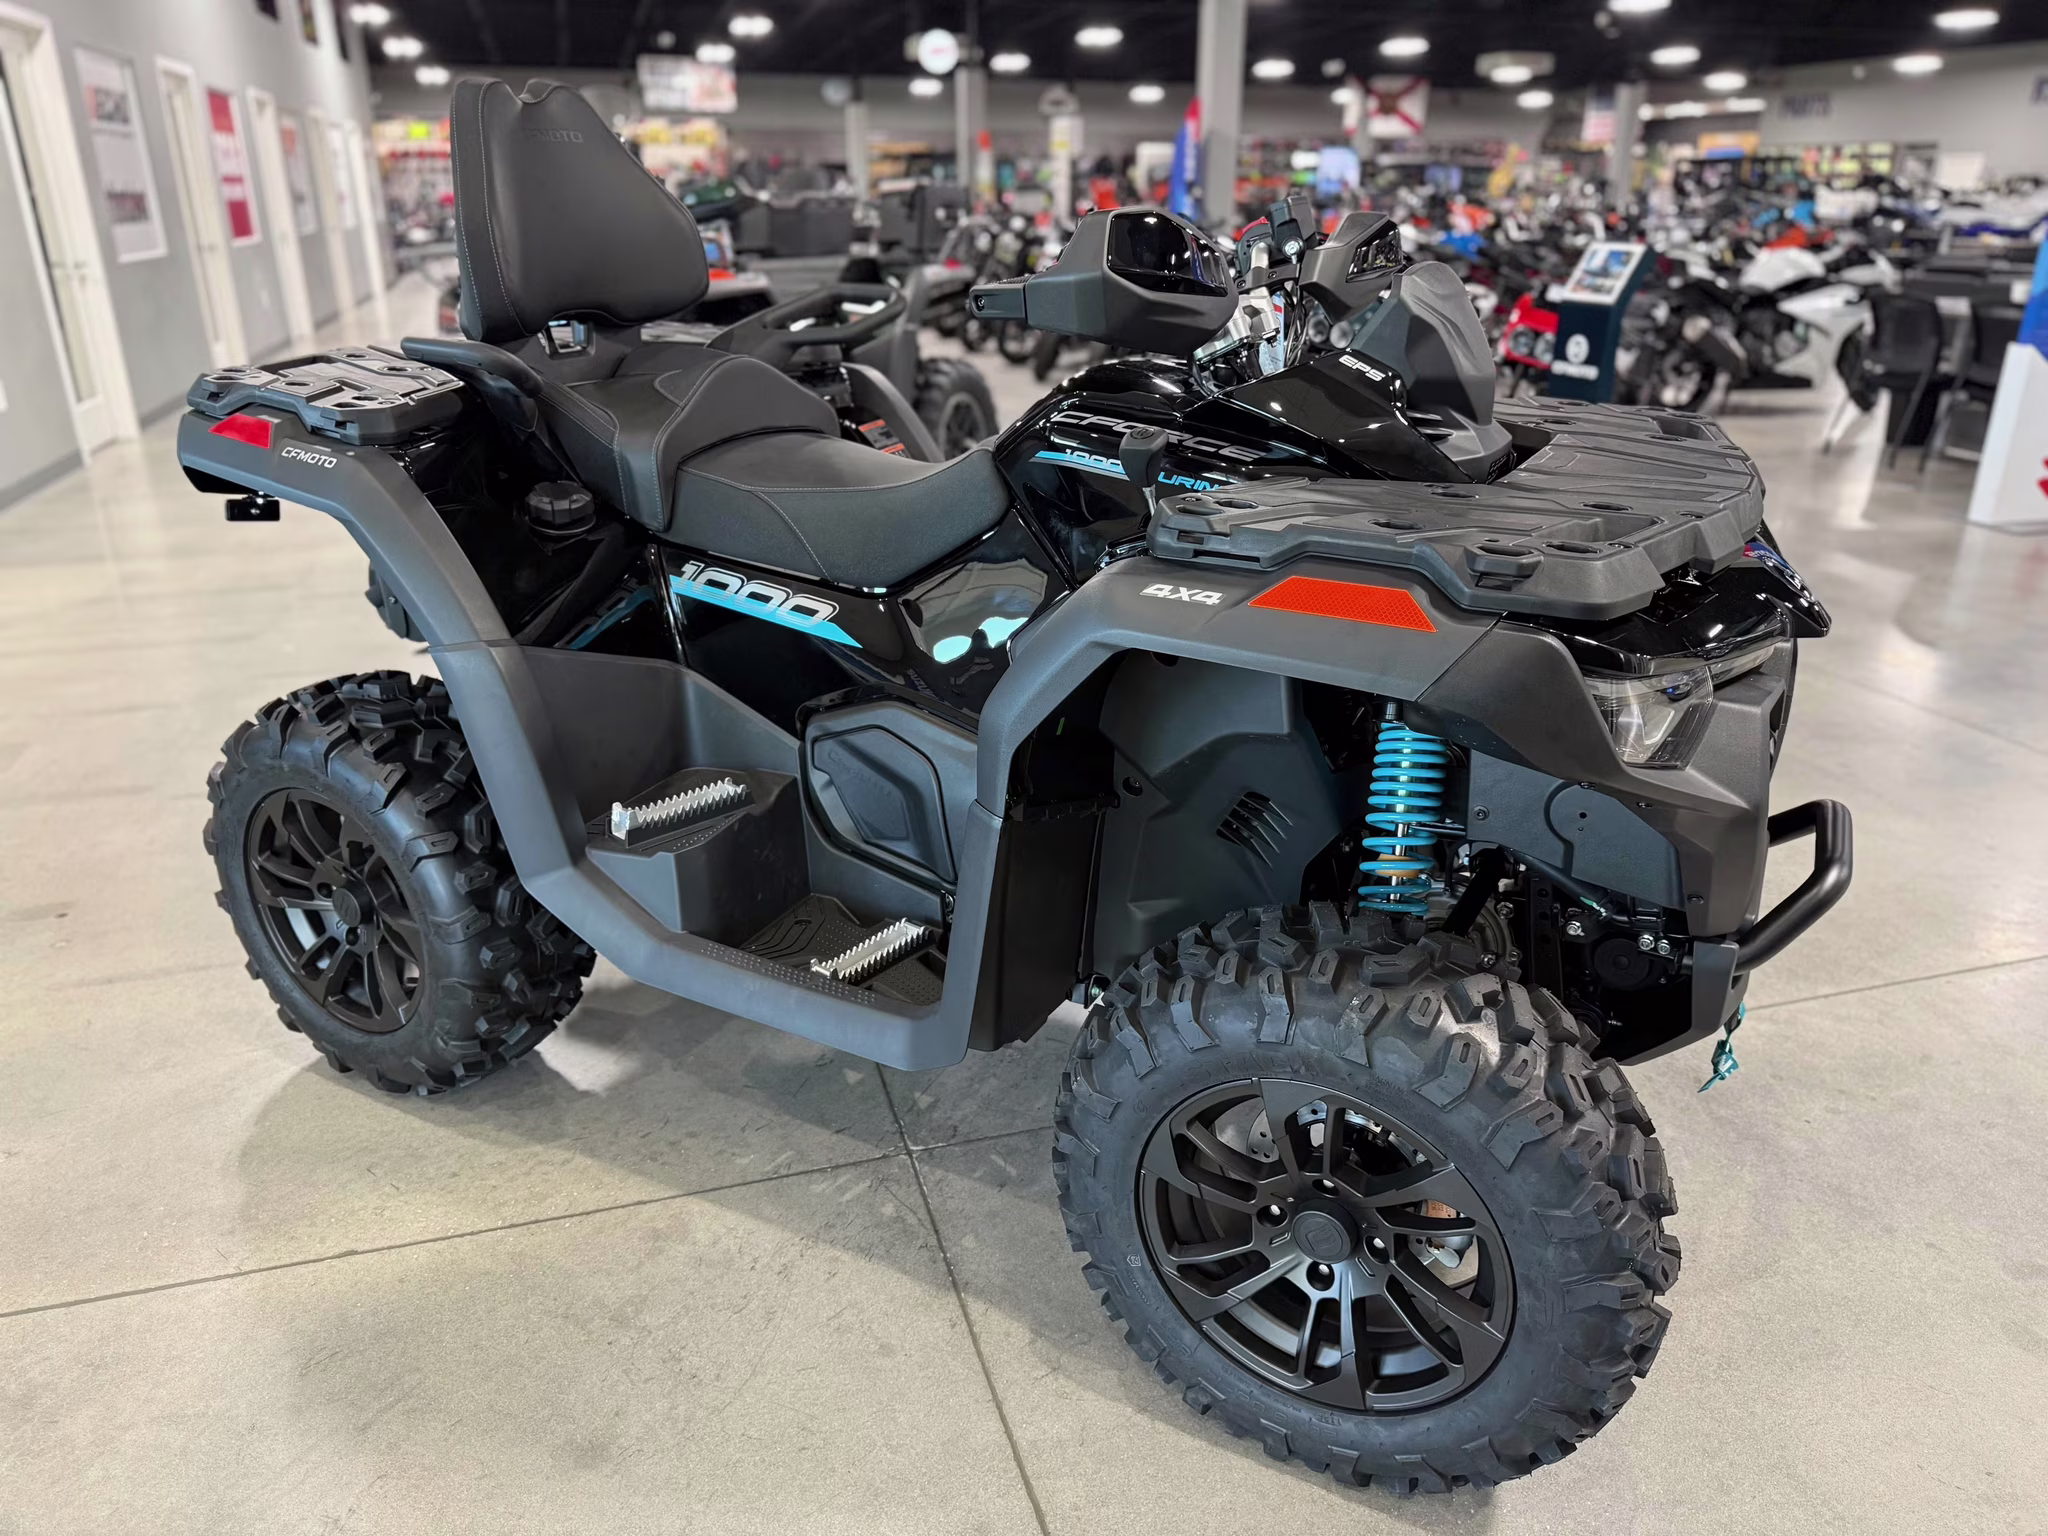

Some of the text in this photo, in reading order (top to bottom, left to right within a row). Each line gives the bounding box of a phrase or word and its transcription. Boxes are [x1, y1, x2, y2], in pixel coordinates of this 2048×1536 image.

[520, 128, 584, 144] FMOTO
[1338, 354, 1386, 382] EPS
[1050, 410, 1267, 462] CFORCE
[281, 446, 338, 469] CFMOTO
[1064, 448, 1222, 491] 1000 URIN
[676, 560, 839, 628] 1000
